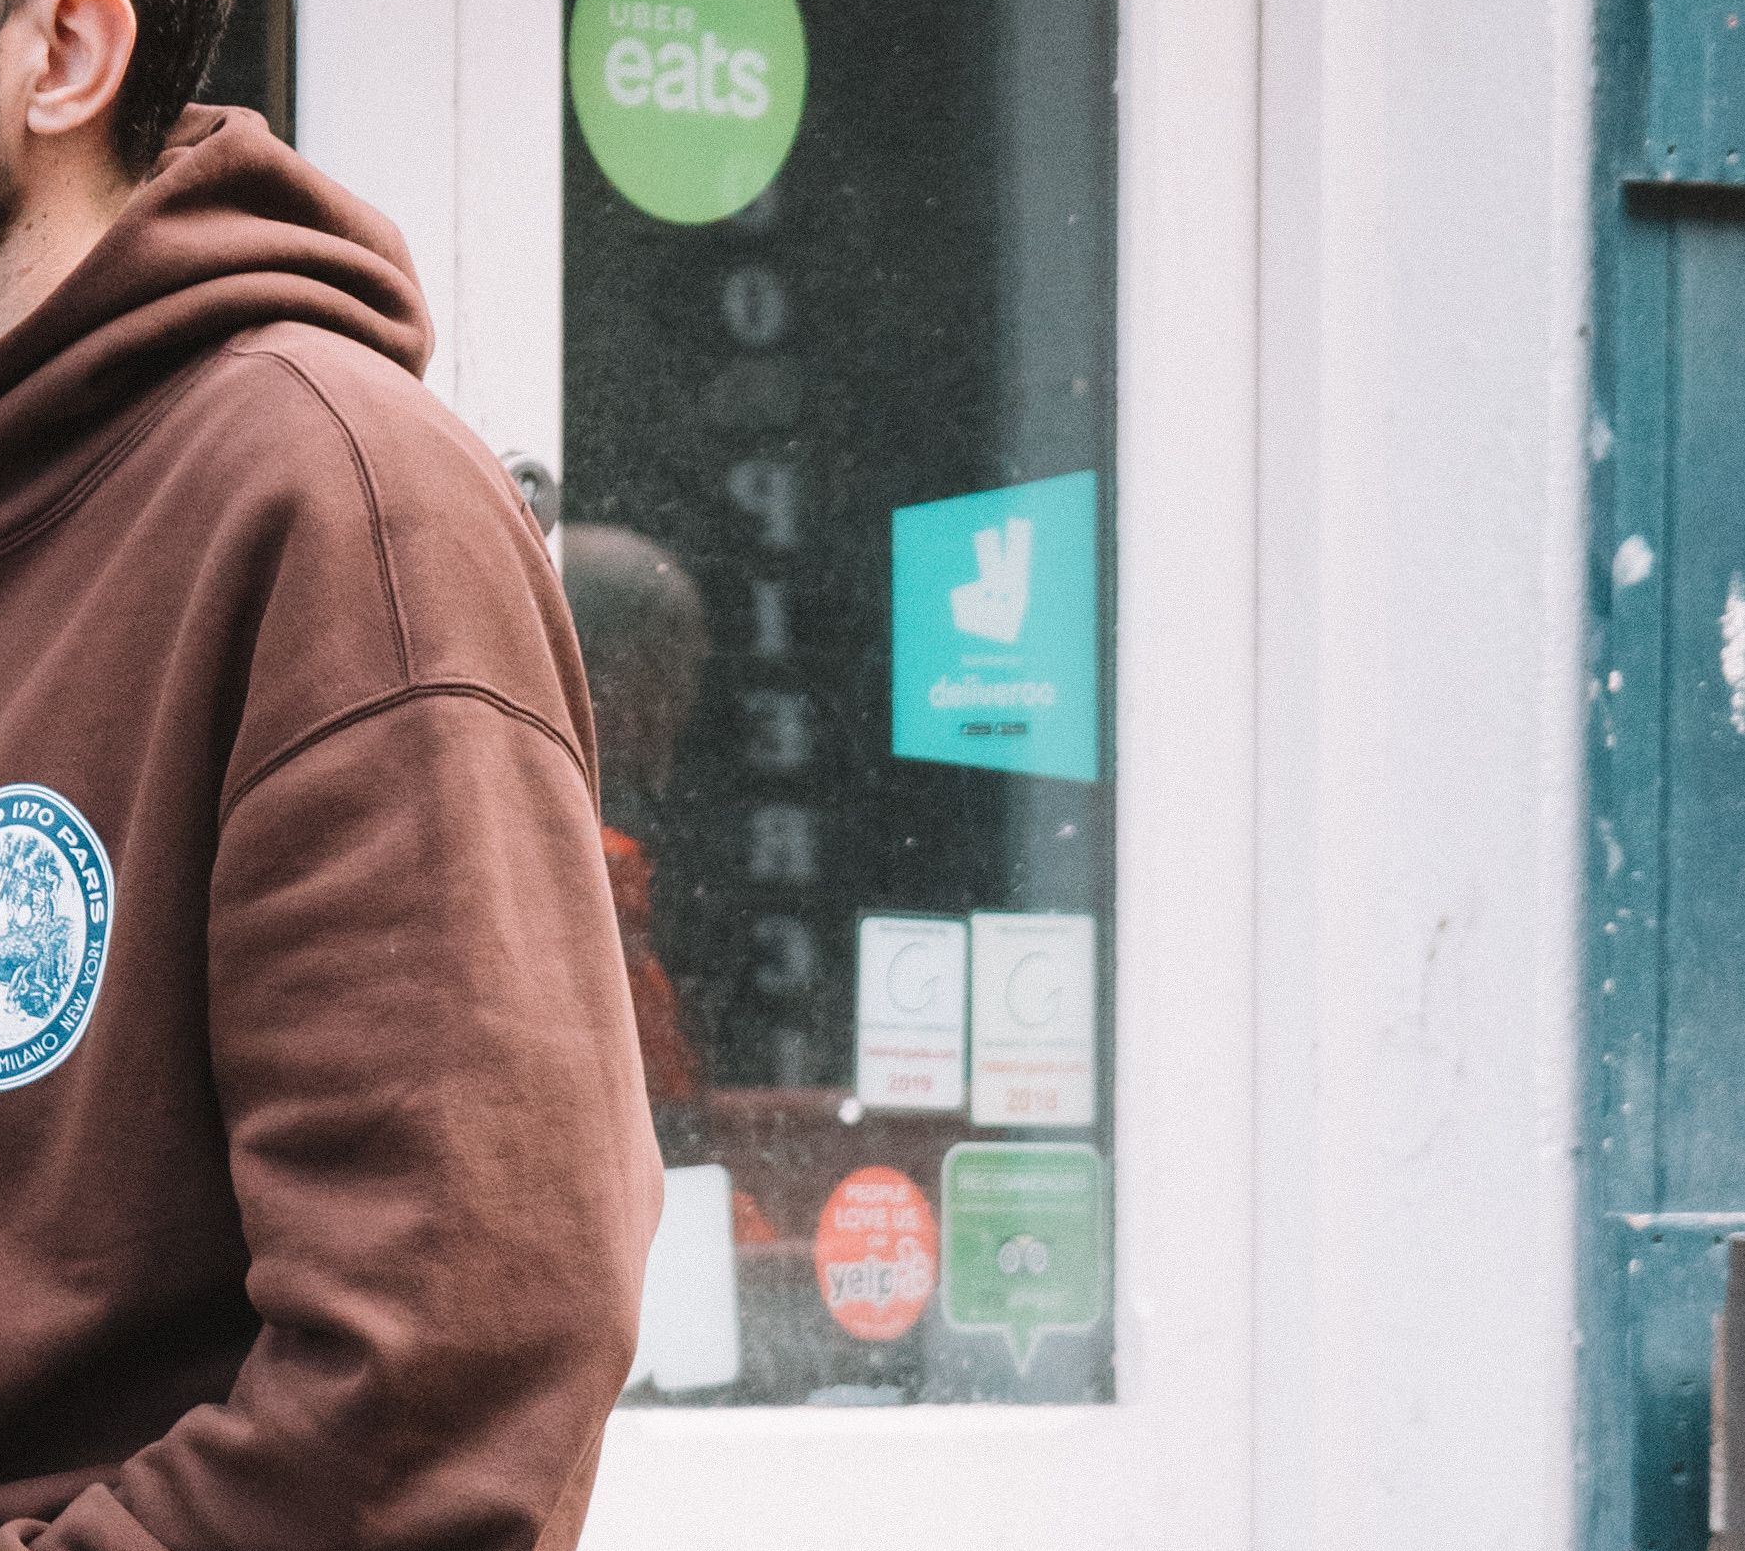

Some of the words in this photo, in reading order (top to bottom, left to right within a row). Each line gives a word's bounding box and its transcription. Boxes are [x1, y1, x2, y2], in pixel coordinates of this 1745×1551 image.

[608, 1, 696, 32] UBER
[604, 32, 769, 118] eats
[11, 800, 55, 827] 1970
[56, 827, 106, 925] PARIS
[59, 994, 87, 1034] NEW
[81, 938, 104, 992] YORK
